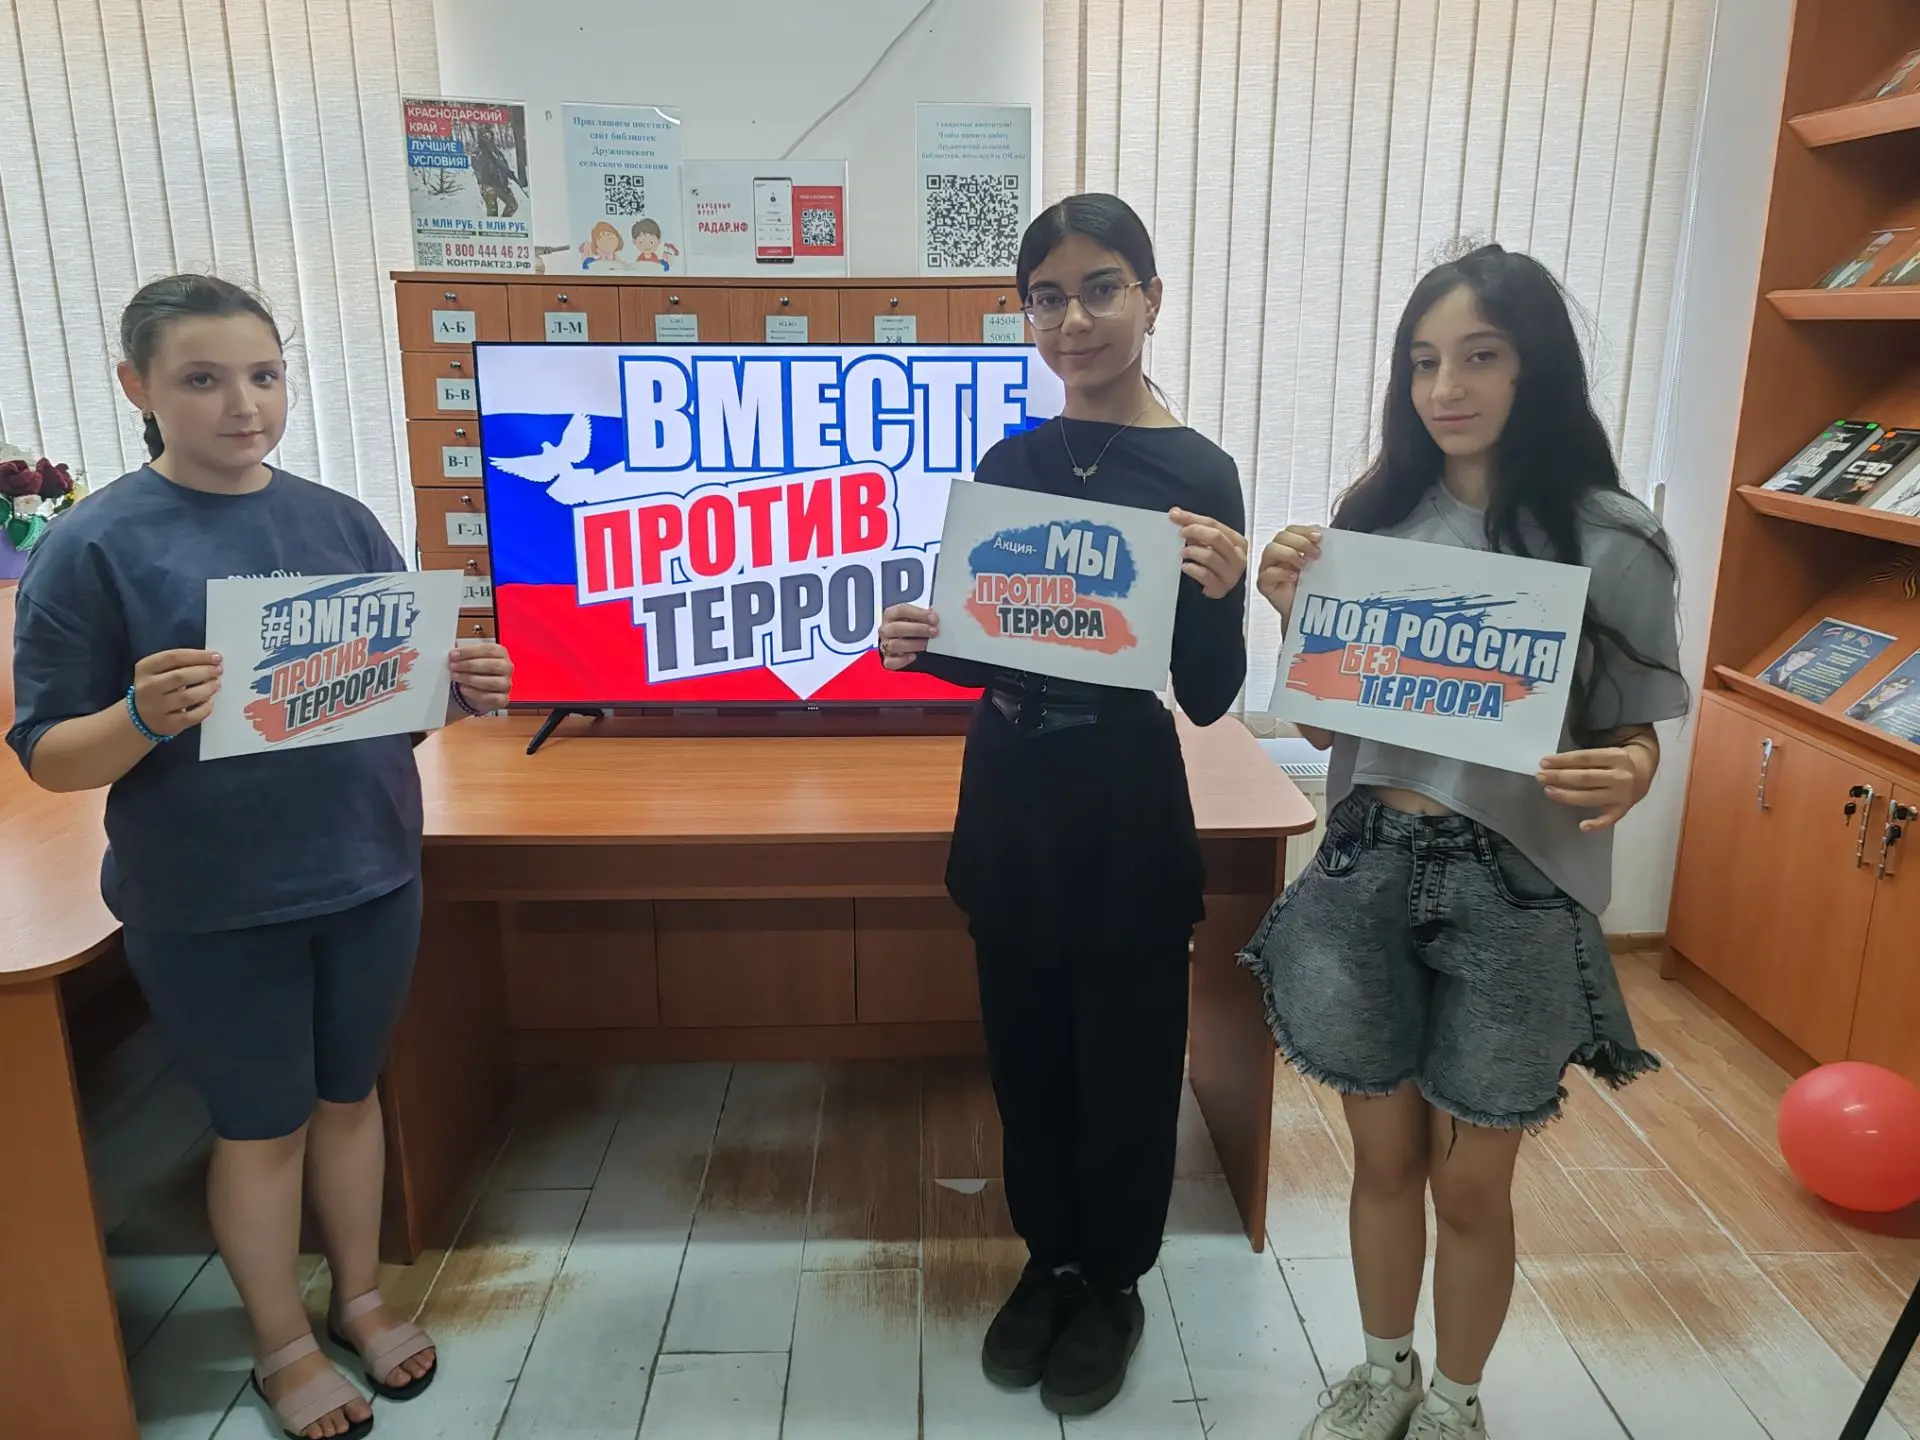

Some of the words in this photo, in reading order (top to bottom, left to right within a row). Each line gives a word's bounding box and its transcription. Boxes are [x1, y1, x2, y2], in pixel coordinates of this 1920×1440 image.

[407, 106, 503, 122] КРАСНОДАРСКИЙ
[409, 121, 438, 132] КРАЙ
[573, 116, 630, 128] Приглашаем
[632, 120, 672, 129] посетить
[589, 131, 608, 140] сайт
[610, 131, 656, 141] библиотек
[411, 141, 457, 152] ЛУЧШИЕ
[412, 155, 468, 167] УСЛОВИЯ!
[578, 160, 622, 169] сельского
[624, 161, 668, 170] поселения
[432, 218, 453, 228] МЛН
[455, 219, 476, 231] РУБ.
[486, 221, 506, 230] МЛН
[508, 222, 529, 232] РУБ.
[698, 222, 749, 234] РАДАР.НФ
[445, 243, 452, 256] 8
[455, 243, 475, 257] 800
[478, 244, 498, 258] 444
[501, 245, 514, 259] 46
[517, 246, 530, 259] 23
[446, 258, 532, 269] КОНТРАКТ23.РФ
[439, 320, 466, 333] А-Б
[551, 320, 584, 334] Л-М
[444, 387, 471, 401] Б-В
[619, 354, 1028, 473] ВМЕСТЕ
[448, 455, 474, 468] В-Г
[457, 523, 484, 537] Г-Д
[582, 470, 891, 595] ПРОТИВ
[993, 536, 1038, 556] Акция-
[1044, 524, 1120, 581] МЫ
[463, 585, 491, 599] Д-И
[976, 573, 1077, 606] ПРОТИВ
[642, 552, 940, 673] ТЕРРОР
[261, 592, 416, 650] #ВМЕСТЕ
[997, 606, 1106, 639] ТЕРРОРА
[1301, 594, 1390, 644] МОЯ
[1397, 612, 1564, 683] РОССИЯ
[1341, 642, 1401, 676] БЕЗ
[270, 636, 369, 705] ПРОТИВ
[285, 657, 399, 731] ТЕРРОРА!
[1358, 674, 1505, 722] ТЕРРОРА
